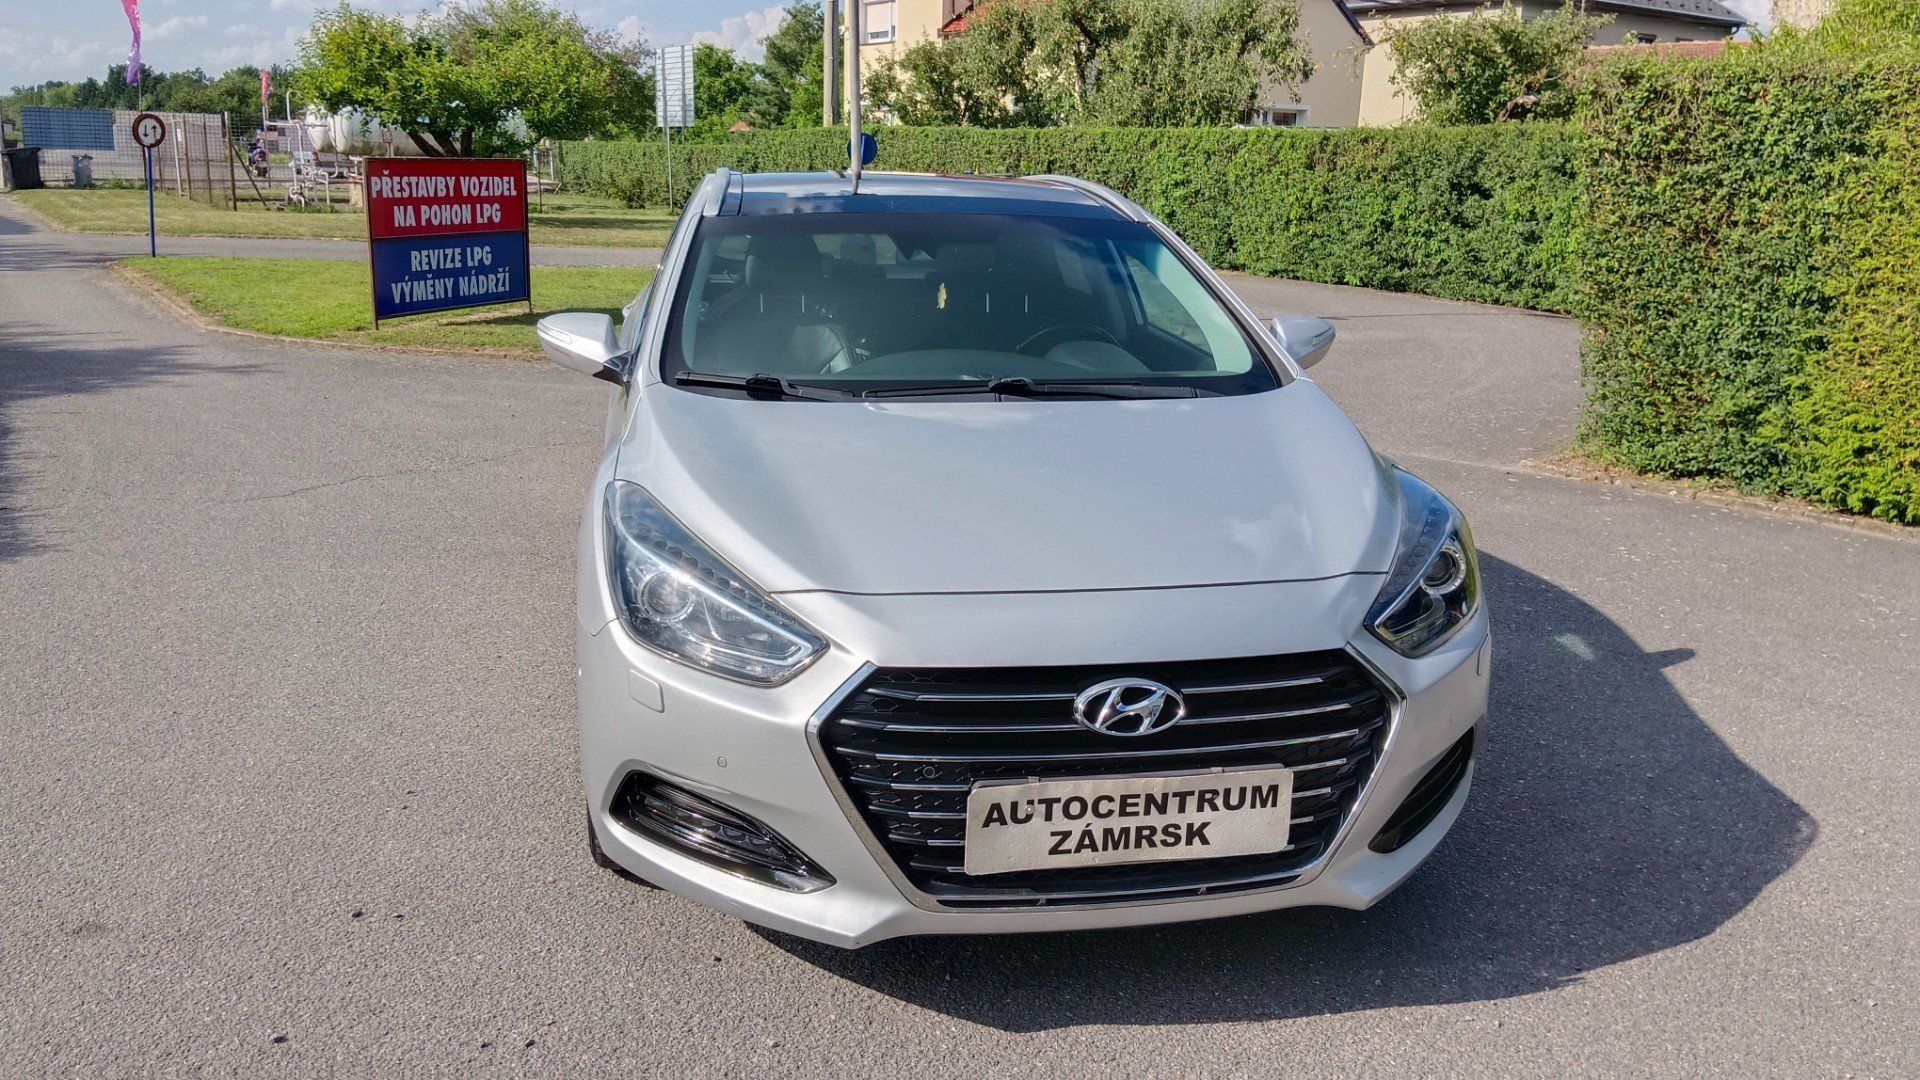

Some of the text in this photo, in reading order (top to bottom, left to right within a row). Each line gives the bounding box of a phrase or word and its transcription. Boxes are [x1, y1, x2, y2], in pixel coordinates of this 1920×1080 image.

[371, 170, 517, 198] PŘESTAVBY VOZIDEL
[393, 203, 501, 227] NA POHON LPG
[410, 246, 492, 271] REVIZE LPG
[391, 267, 510, 304] VÝMĚNY NÁDRŽÍ
[981, 784, 1279, 828] AUTOCENTRUM
[1048, 821, 1211, 856] ZÁMRSK
